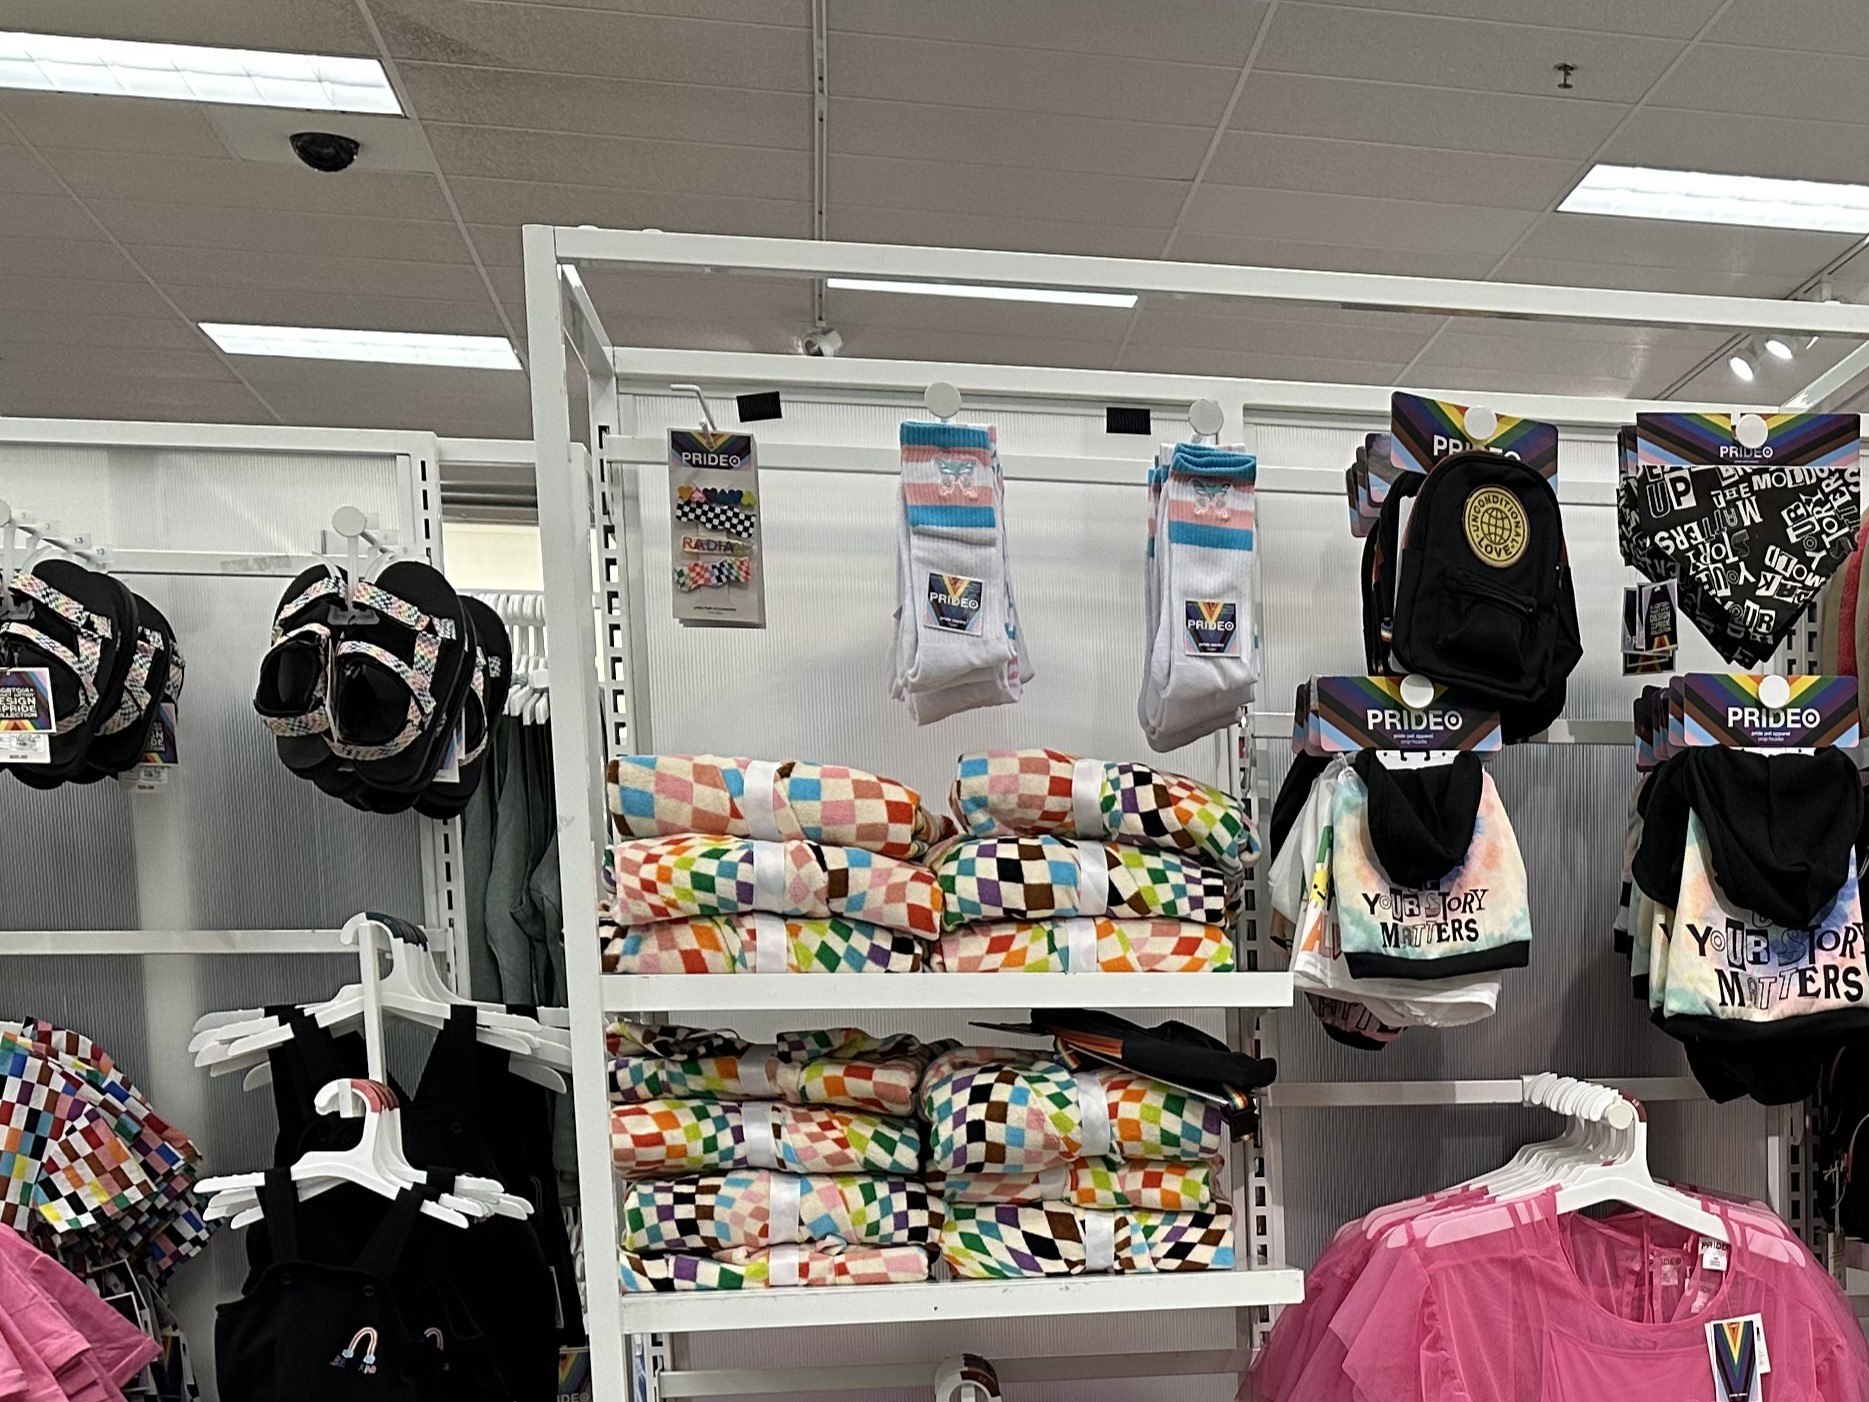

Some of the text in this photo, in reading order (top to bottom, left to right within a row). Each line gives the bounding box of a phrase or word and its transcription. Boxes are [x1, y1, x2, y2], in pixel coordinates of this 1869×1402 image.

[682, 452, 729, 467] PRIDE
[1720, 446, 1762, 458] PRIDE
[1471, 494, 1522, 547] UNCONDITIONAL
[1478, 536, 1513, 558] LOVE
[930, 592, 968, 609] PRIDE
[1187, 619, 1225, 631] PRIDE
[1366, 709, 1444, 730] PRIDE
[1727, 707, 1800, 728] PRIDE
[1362, 886, 1489, 922] YOUR STORY
[1380, 918, 1479, 948] MATTERS
[1686, 917, 1770, 971] YOUR
[1715, 963, 1864, 1010] MATTERS
